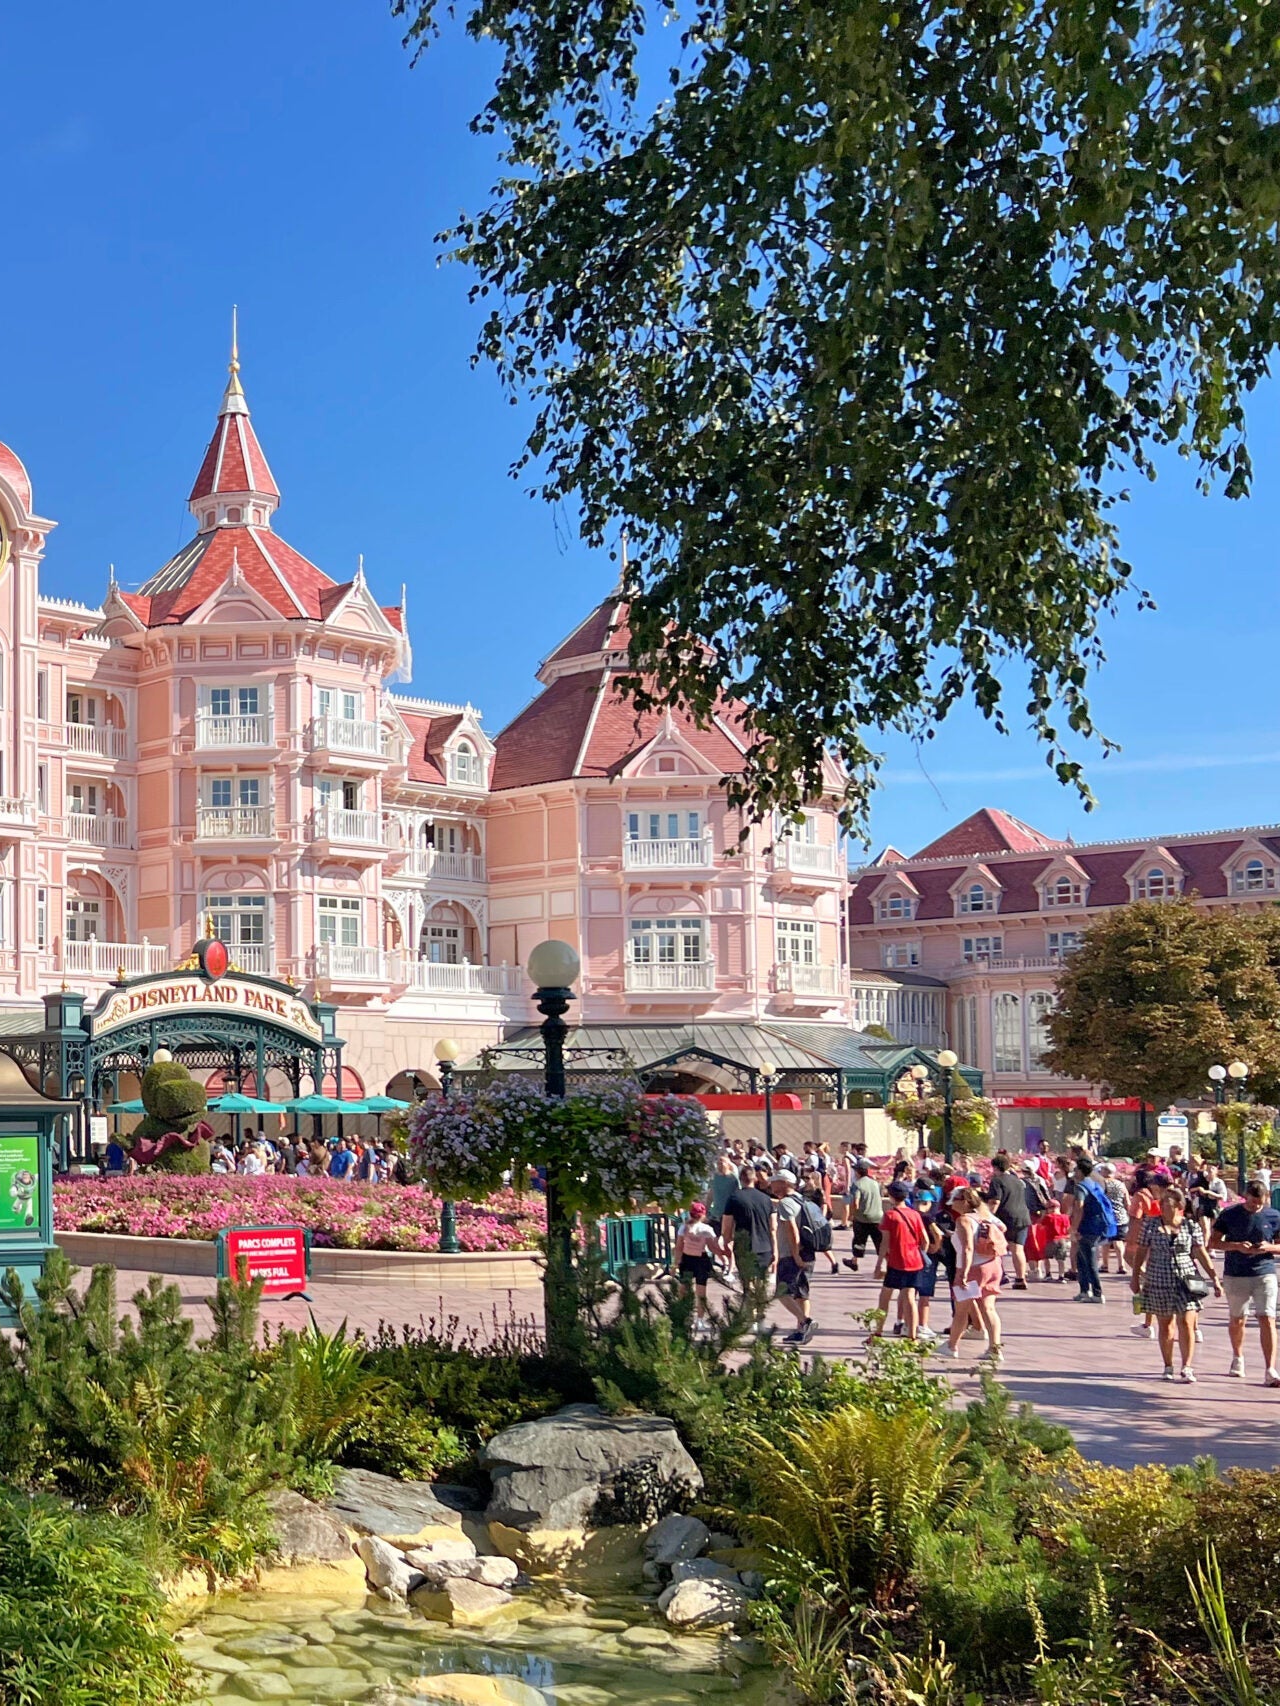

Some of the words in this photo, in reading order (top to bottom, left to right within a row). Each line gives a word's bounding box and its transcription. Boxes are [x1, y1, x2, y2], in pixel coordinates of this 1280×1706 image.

[128, 983, 238, 1014] DISNEYLAND
[243, 987, 289, 1018] PARK
[238, 1239, 261, 1249] PARCS
[261, 1237, 296, 1248] COMPLETS
[272, 1267, 290, 1277] FULL
